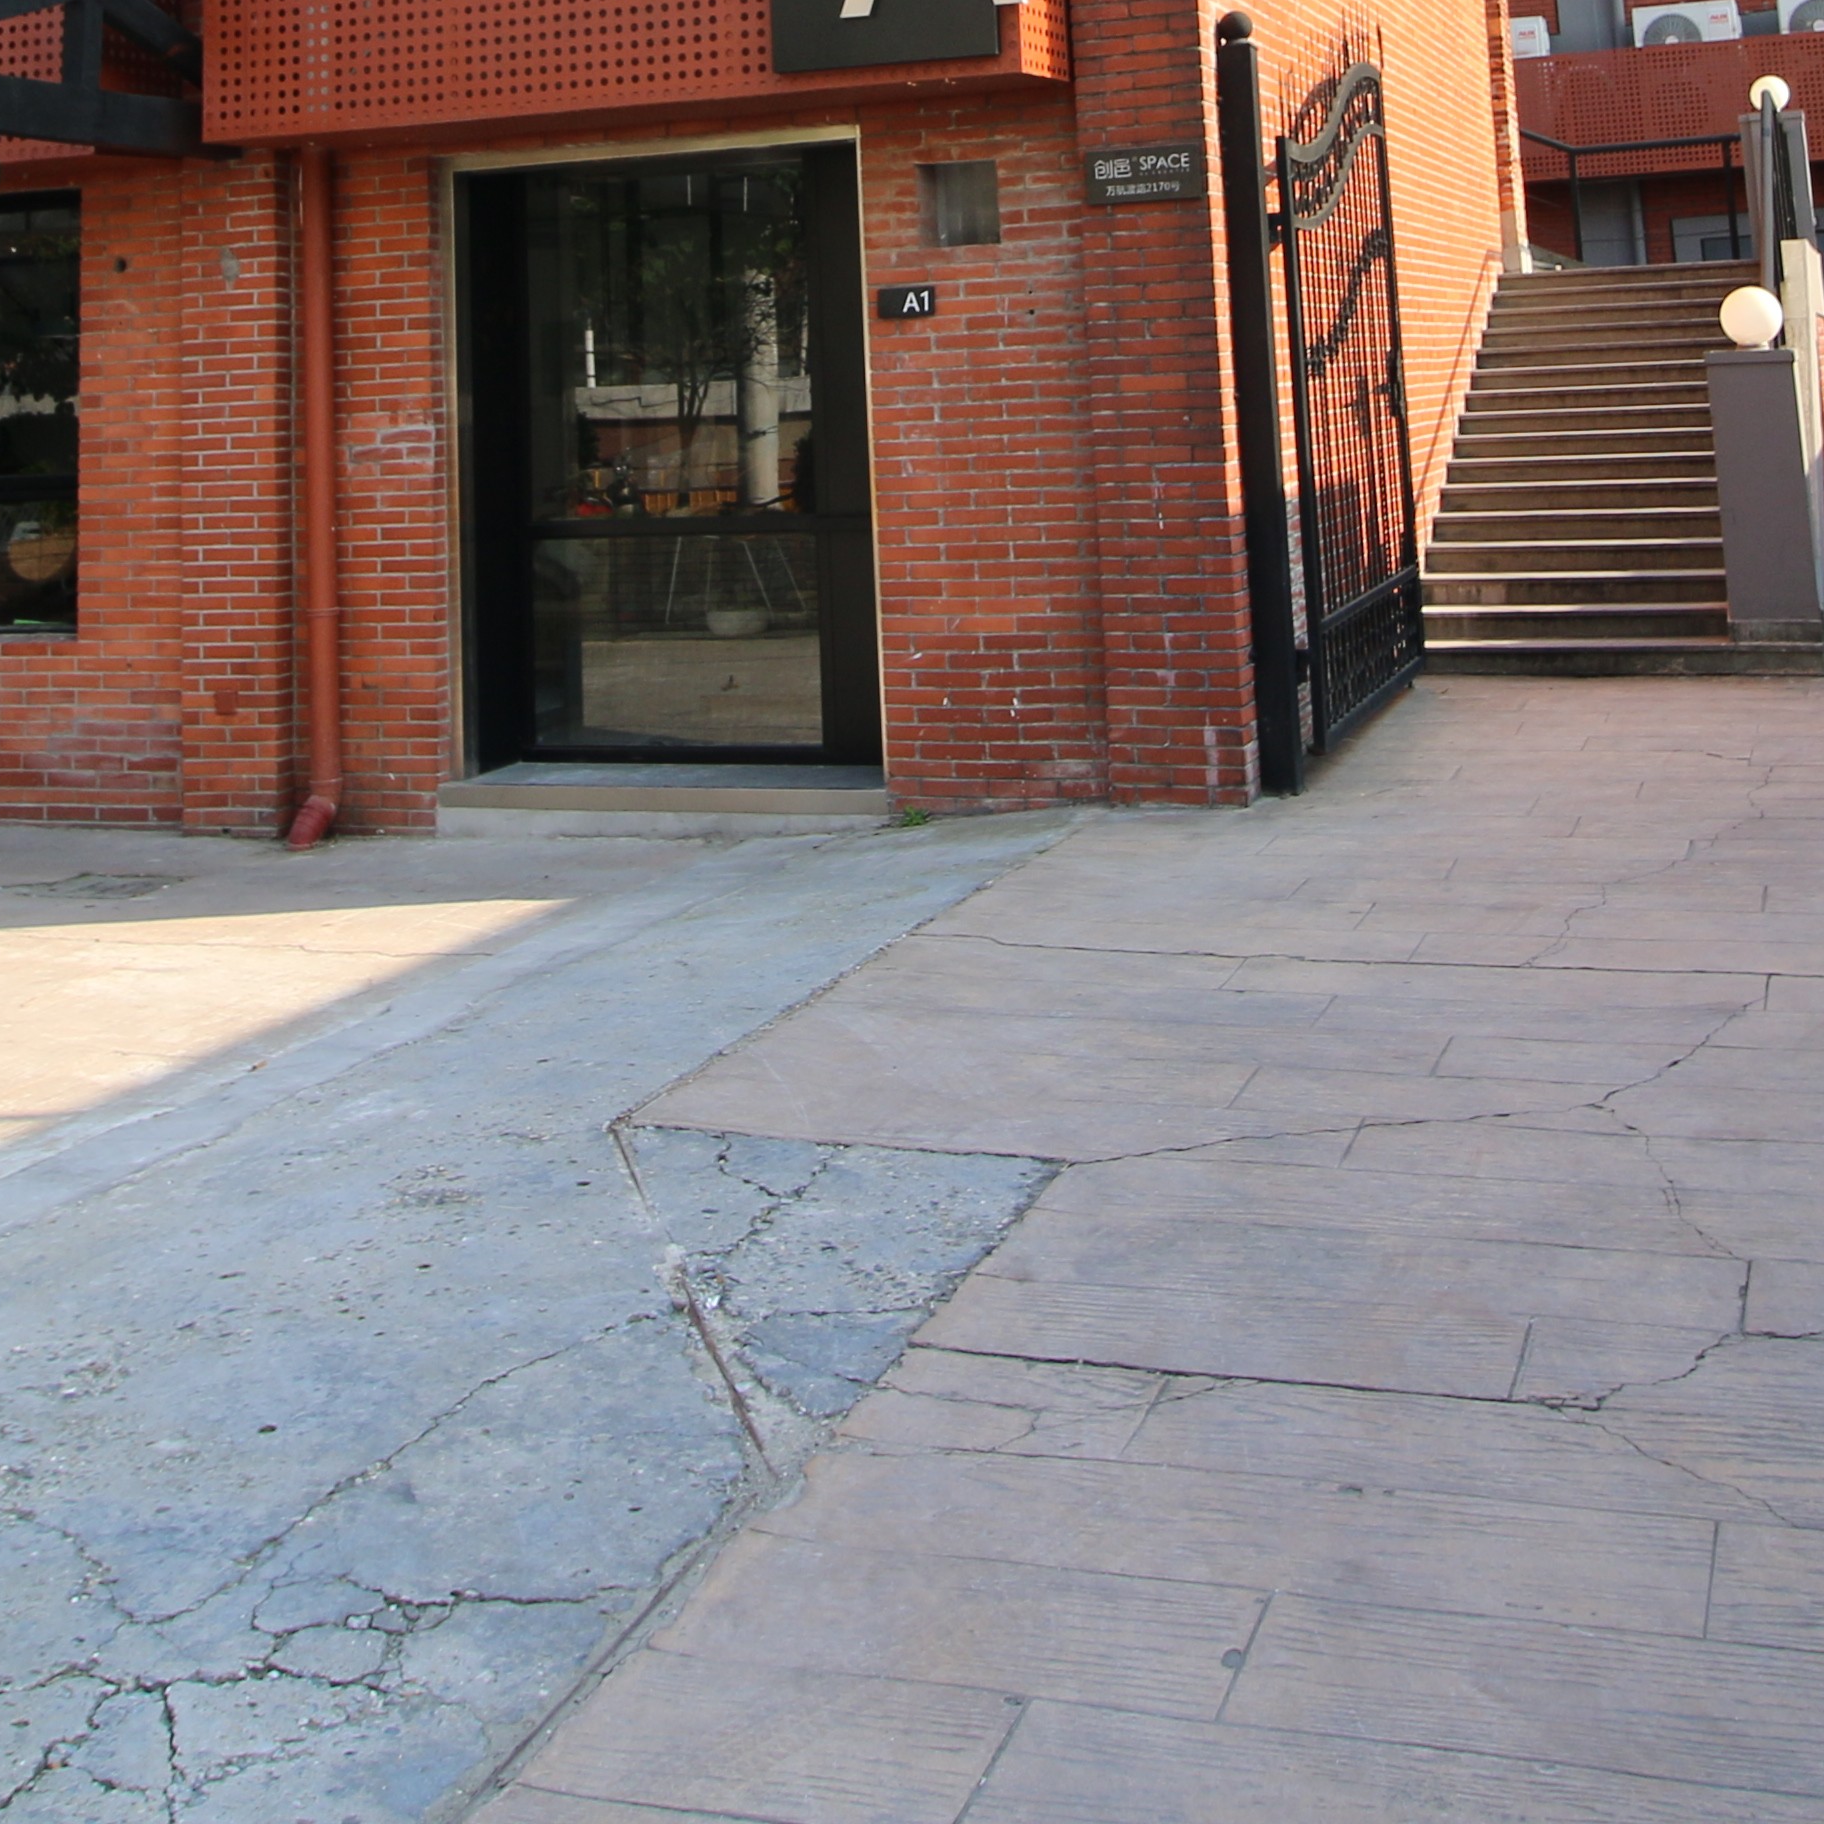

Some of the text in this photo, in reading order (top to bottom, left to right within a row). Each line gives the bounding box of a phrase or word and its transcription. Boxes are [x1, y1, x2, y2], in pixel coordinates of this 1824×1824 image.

[1094, 158, 1132, 180] 创邑
[1139, 152, 1190, 171] SPACE
[902, 290, 929, 313] A1
